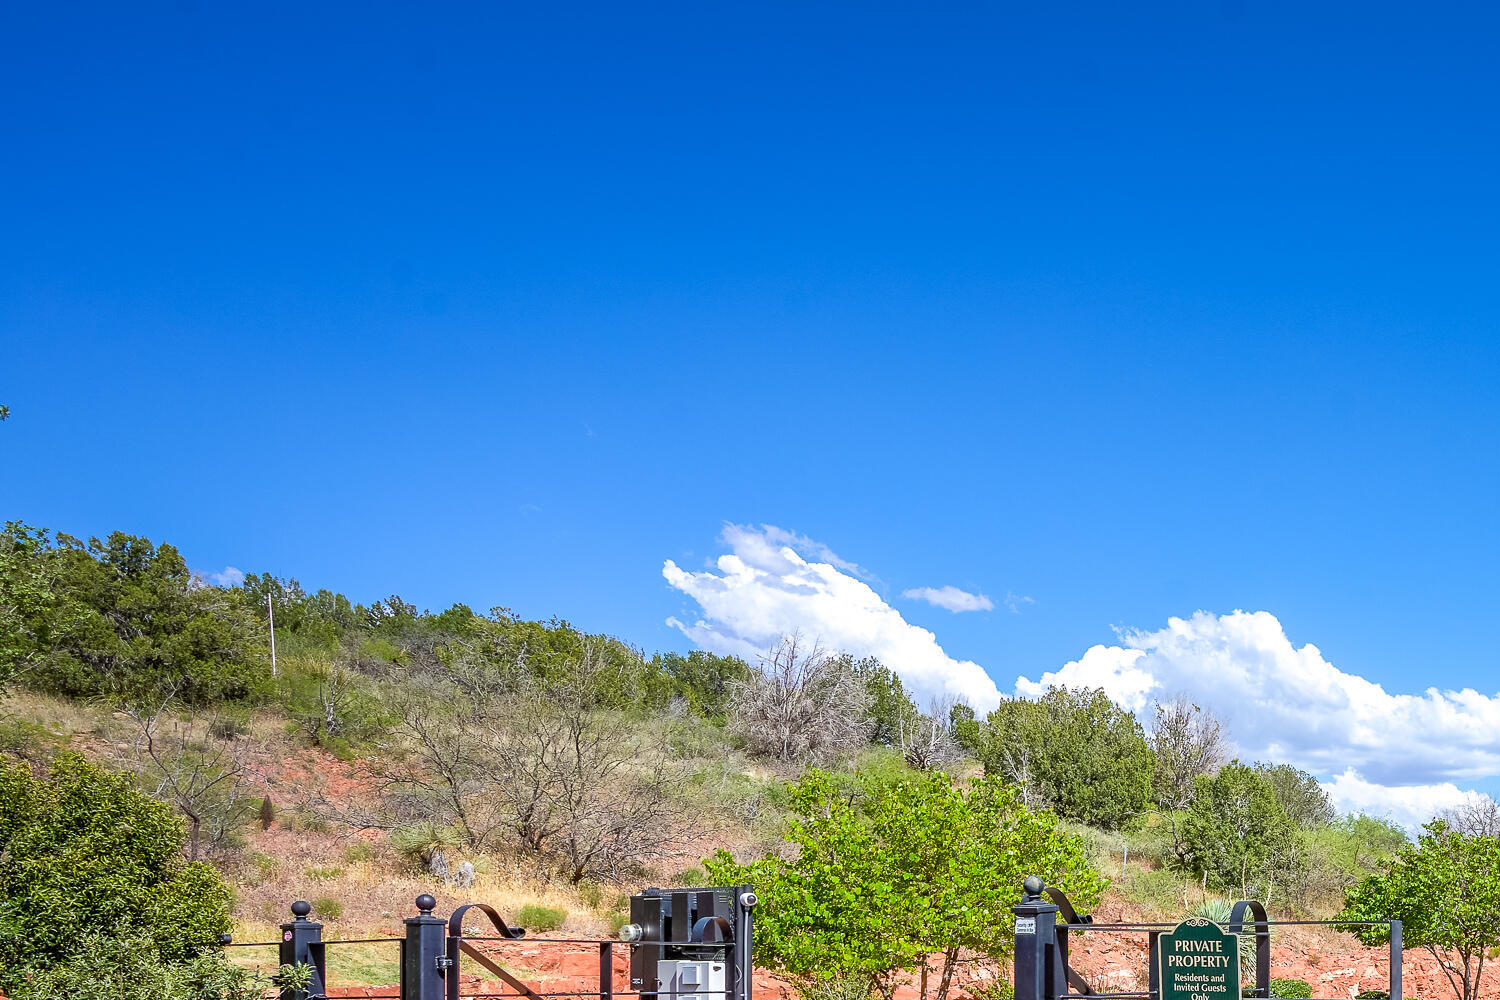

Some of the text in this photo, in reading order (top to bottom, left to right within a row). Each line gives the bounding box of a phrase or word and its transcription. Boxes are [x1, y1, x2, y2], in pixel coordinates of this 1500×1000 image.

[1175, 940, 1223, 952] PRIVATE
[1168, 955, 1230, 968] PROPERTY
[1174, 973, 1225, 983] Residents and
[1173, 983, 1227, 993] Invited Guests
